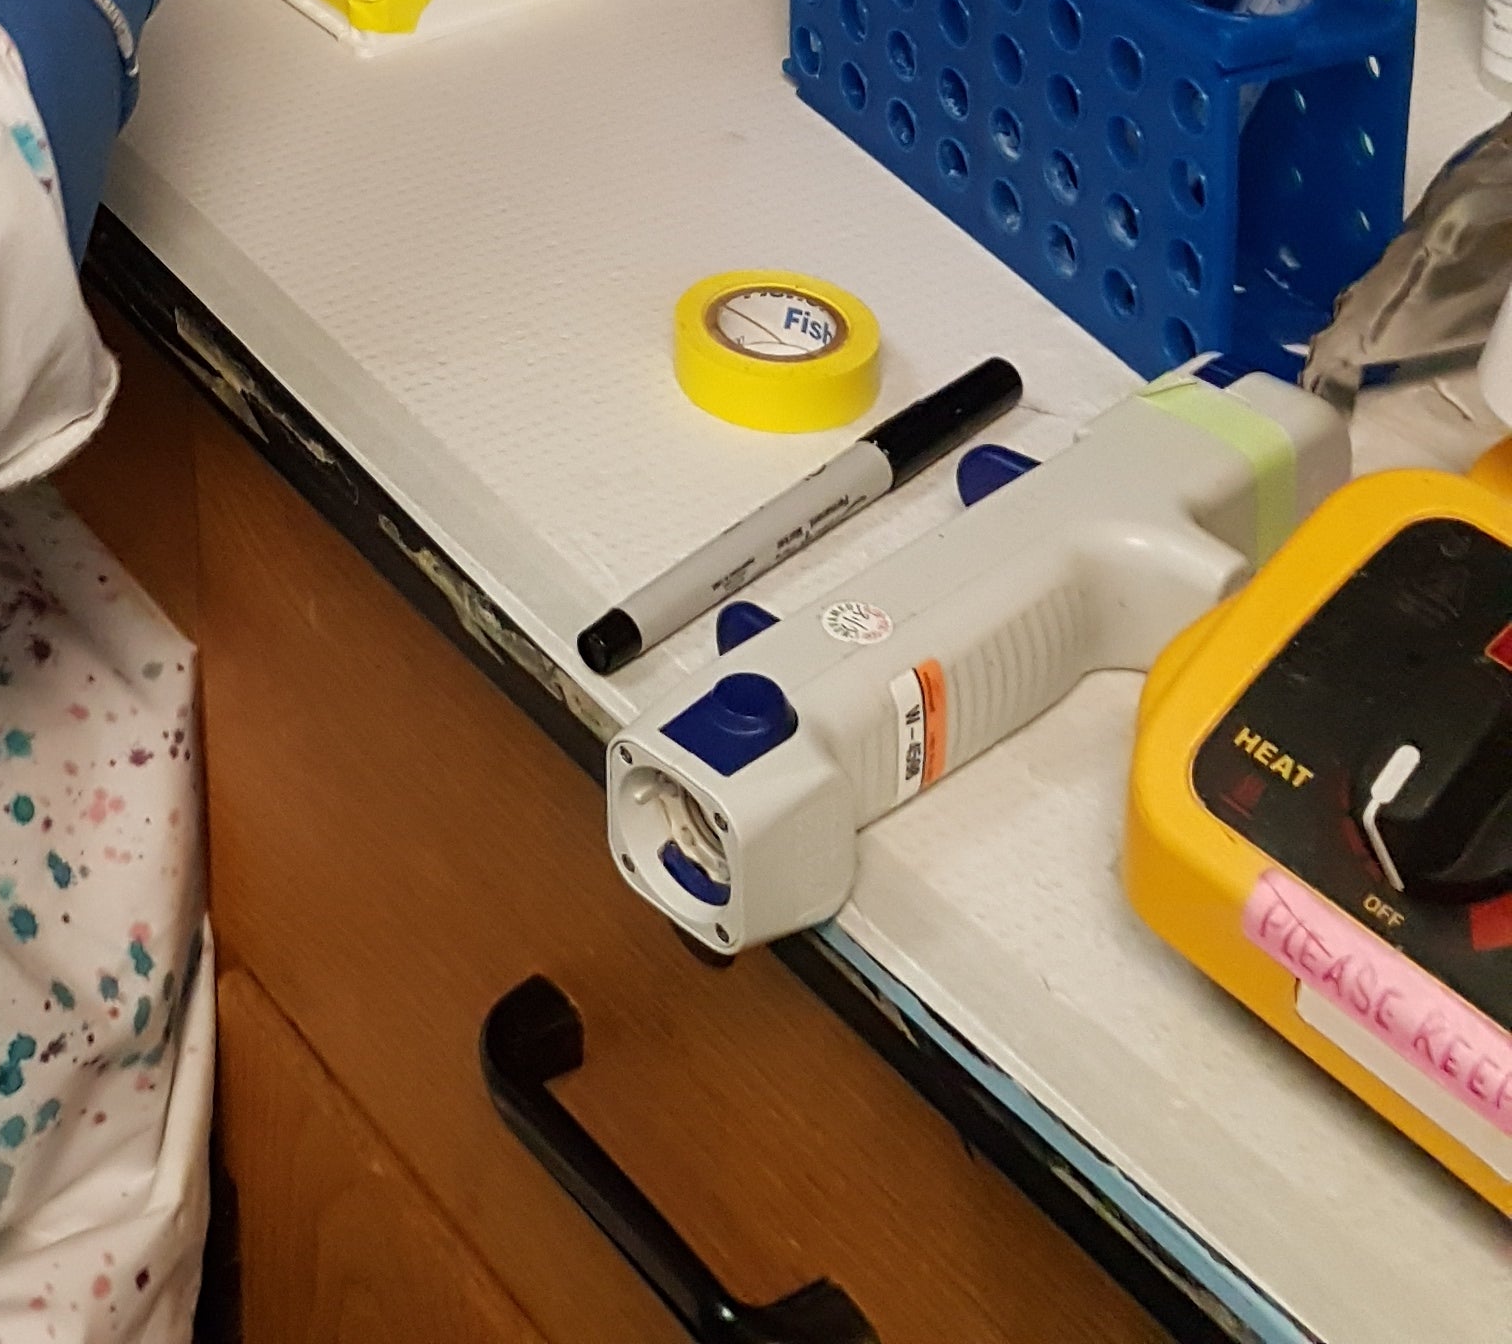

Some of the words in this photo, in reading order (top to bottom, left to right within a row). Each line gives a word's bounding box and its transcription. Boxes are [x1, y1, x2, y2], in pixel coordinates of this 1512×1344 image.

[1233, 725, 1316, 789] HEAT
[1361, 893, 1406, 928] OFF
[1258, 897, 1407, 1032] PLEASE
